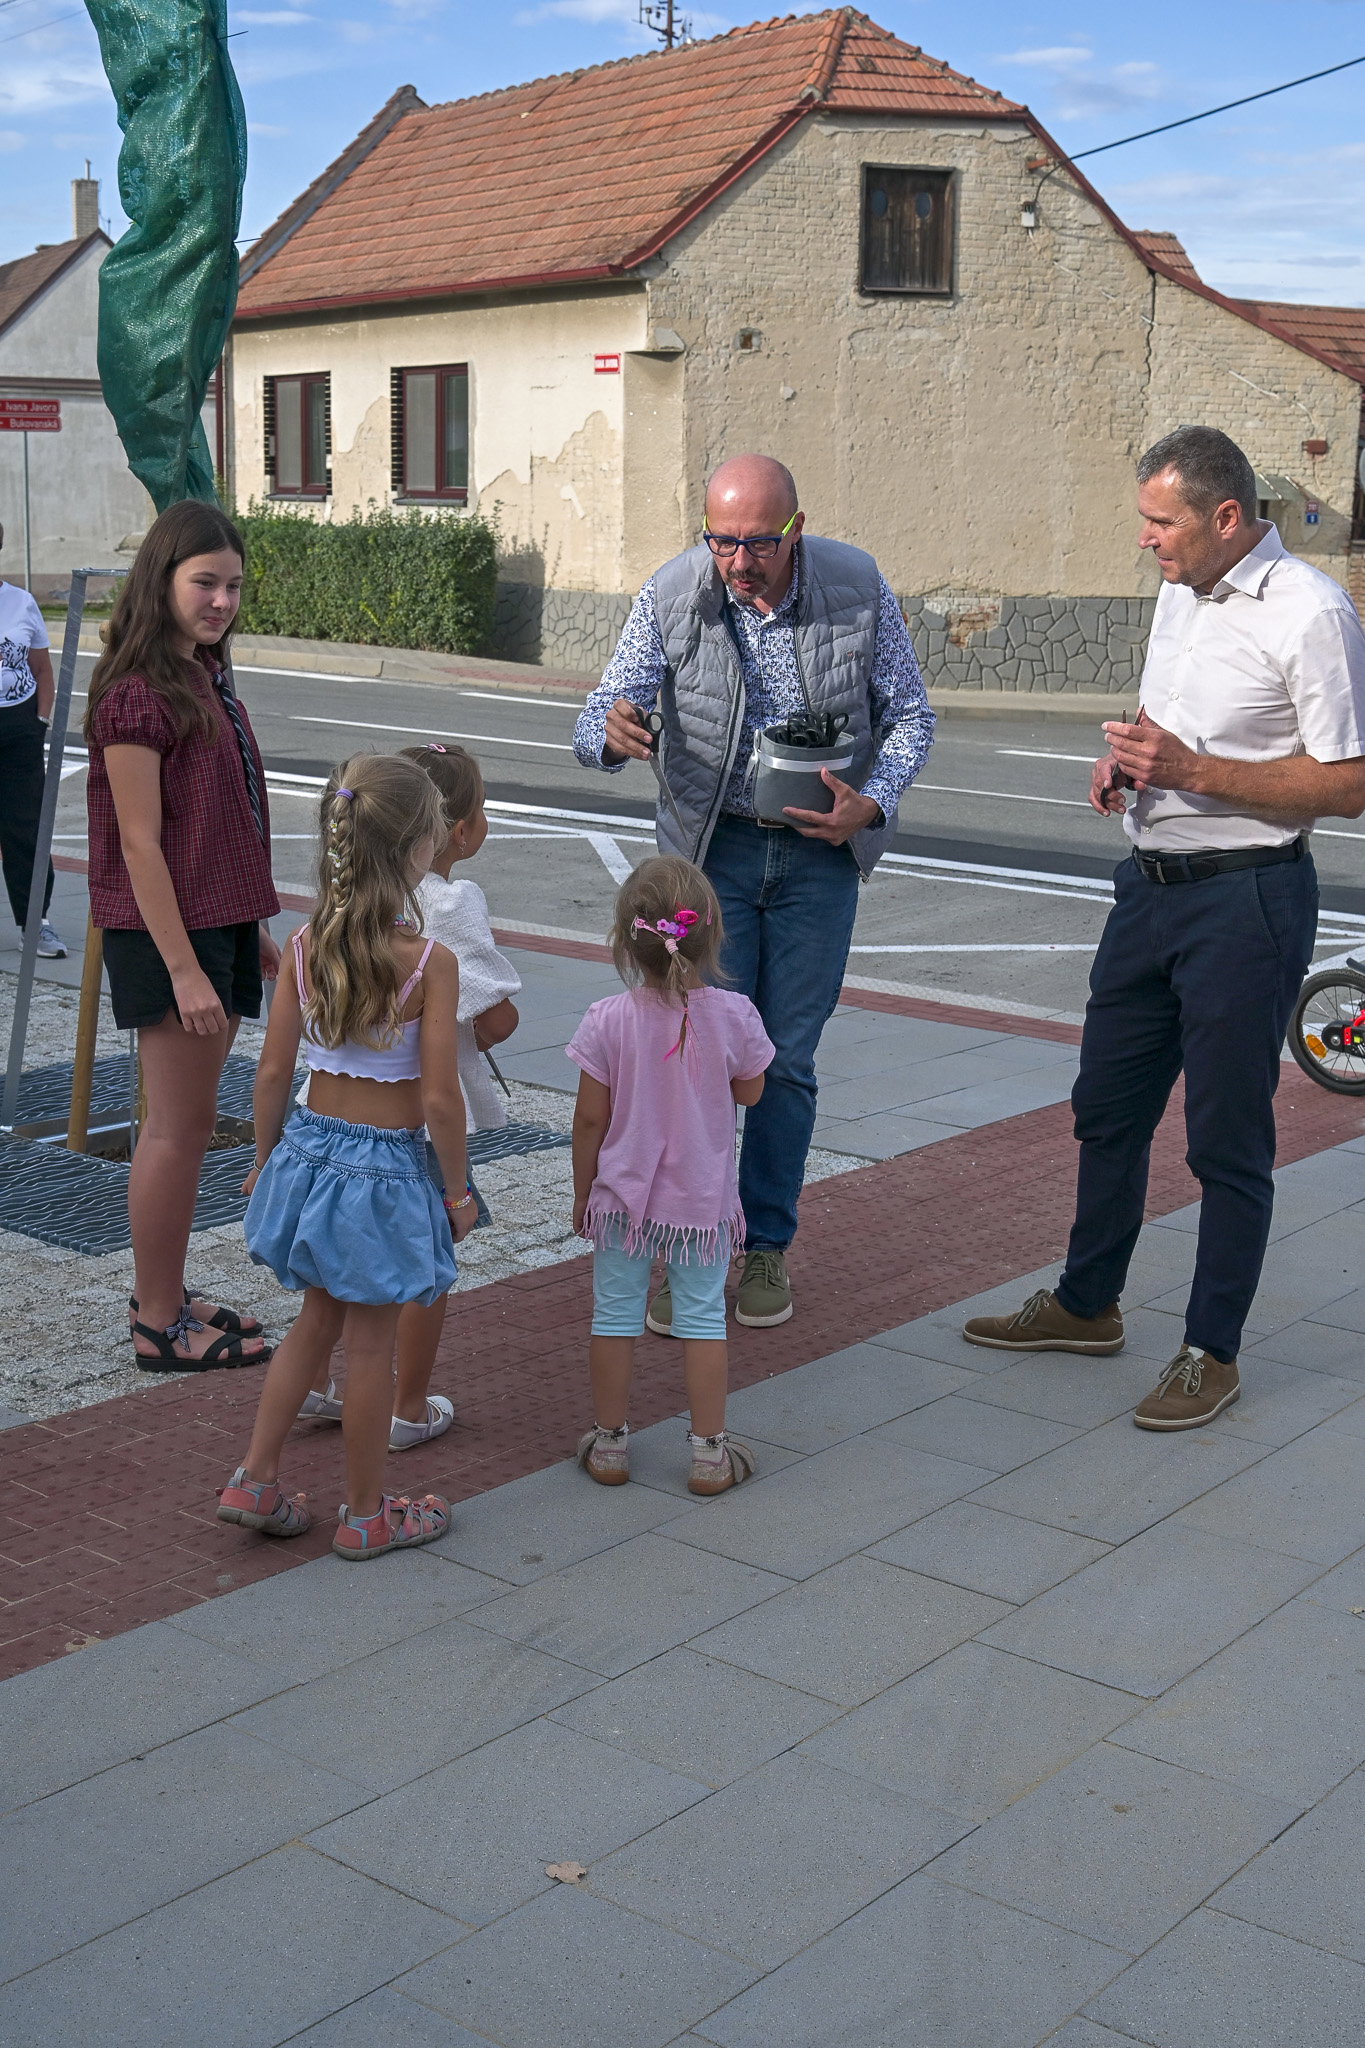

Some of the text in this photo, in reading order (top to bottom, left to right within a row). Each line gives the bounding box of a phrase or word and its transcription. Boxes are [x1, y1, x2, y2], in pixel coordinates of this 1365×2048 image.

[5, 402, 57, 412] Ivana Javora
[10, 418, 58, 428] Bukovanská
